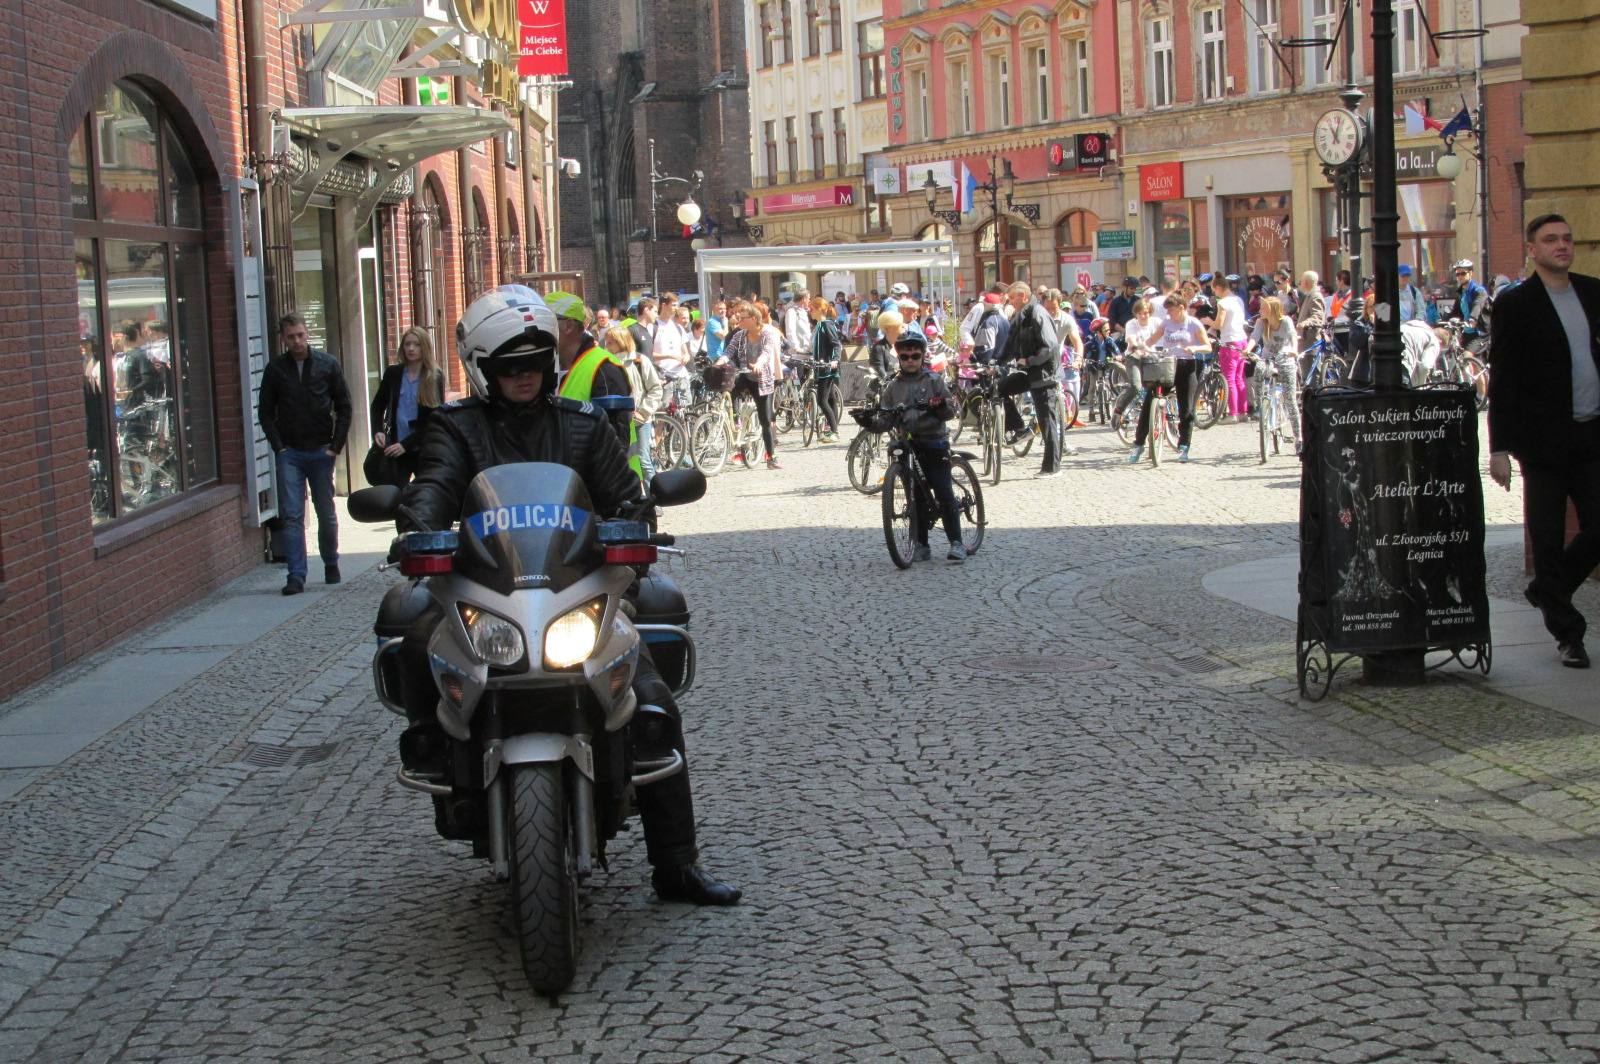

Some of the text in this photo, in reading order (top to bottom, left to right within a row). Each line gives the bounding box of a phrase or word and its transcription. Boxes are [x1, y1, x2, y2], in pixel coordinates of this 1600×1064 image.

[525, 35, 557, 45] Miejsce
[520, 46, 563, 56] dla Ciebie
[1146, 175, 1173, 191] SALON
[1238, 216, 1288, 250] PERFUMERIA
[1252, 231, 1274, 253] Styl
[1330, 405, 1463, 426] Salon Sukien Ślubnych
[1354, 425, 1446, 444] i wieczorowych
[1370, 479, 1465, 500] Atelier L'Arte
[482, 504, 574, 536] POLICJA
[1375, 534, 1388, 546] ul.
[1392, 531, 1447, 547] Złotoryjska
[1406, 548, 1444, 562] Legnica
[514, 574, 551, 582] HONDA
[1342, 613, 1364, 621] Iwona
[1342, 624, 1352, 632] tel.
